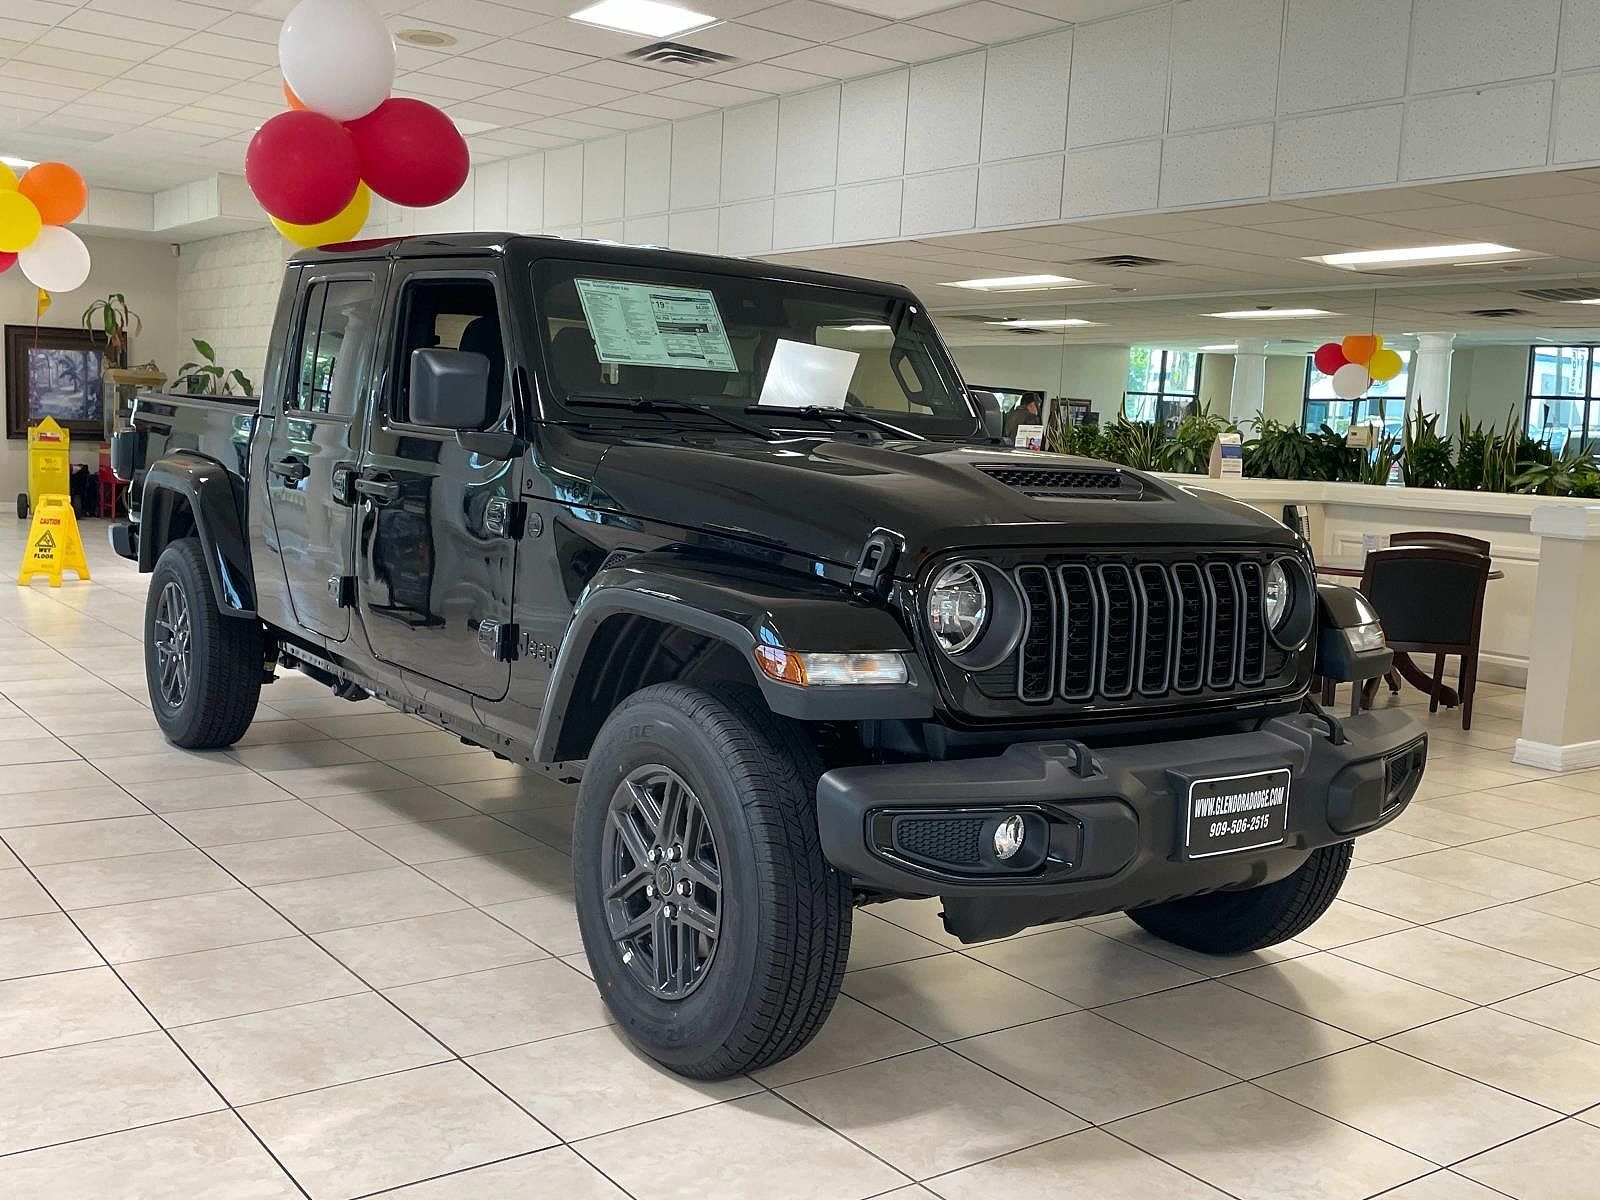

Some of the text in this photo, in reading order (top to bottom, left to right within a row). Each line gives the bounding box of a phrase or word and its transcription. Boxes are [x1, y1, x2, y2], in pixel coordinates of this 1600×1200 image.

[520, 632, 558, 669] Jeep
[1194, 786, 1285, 818] WWW.GLENDORADODGE.COM
[1209, 814, 1270, 838] 909-506-2515
